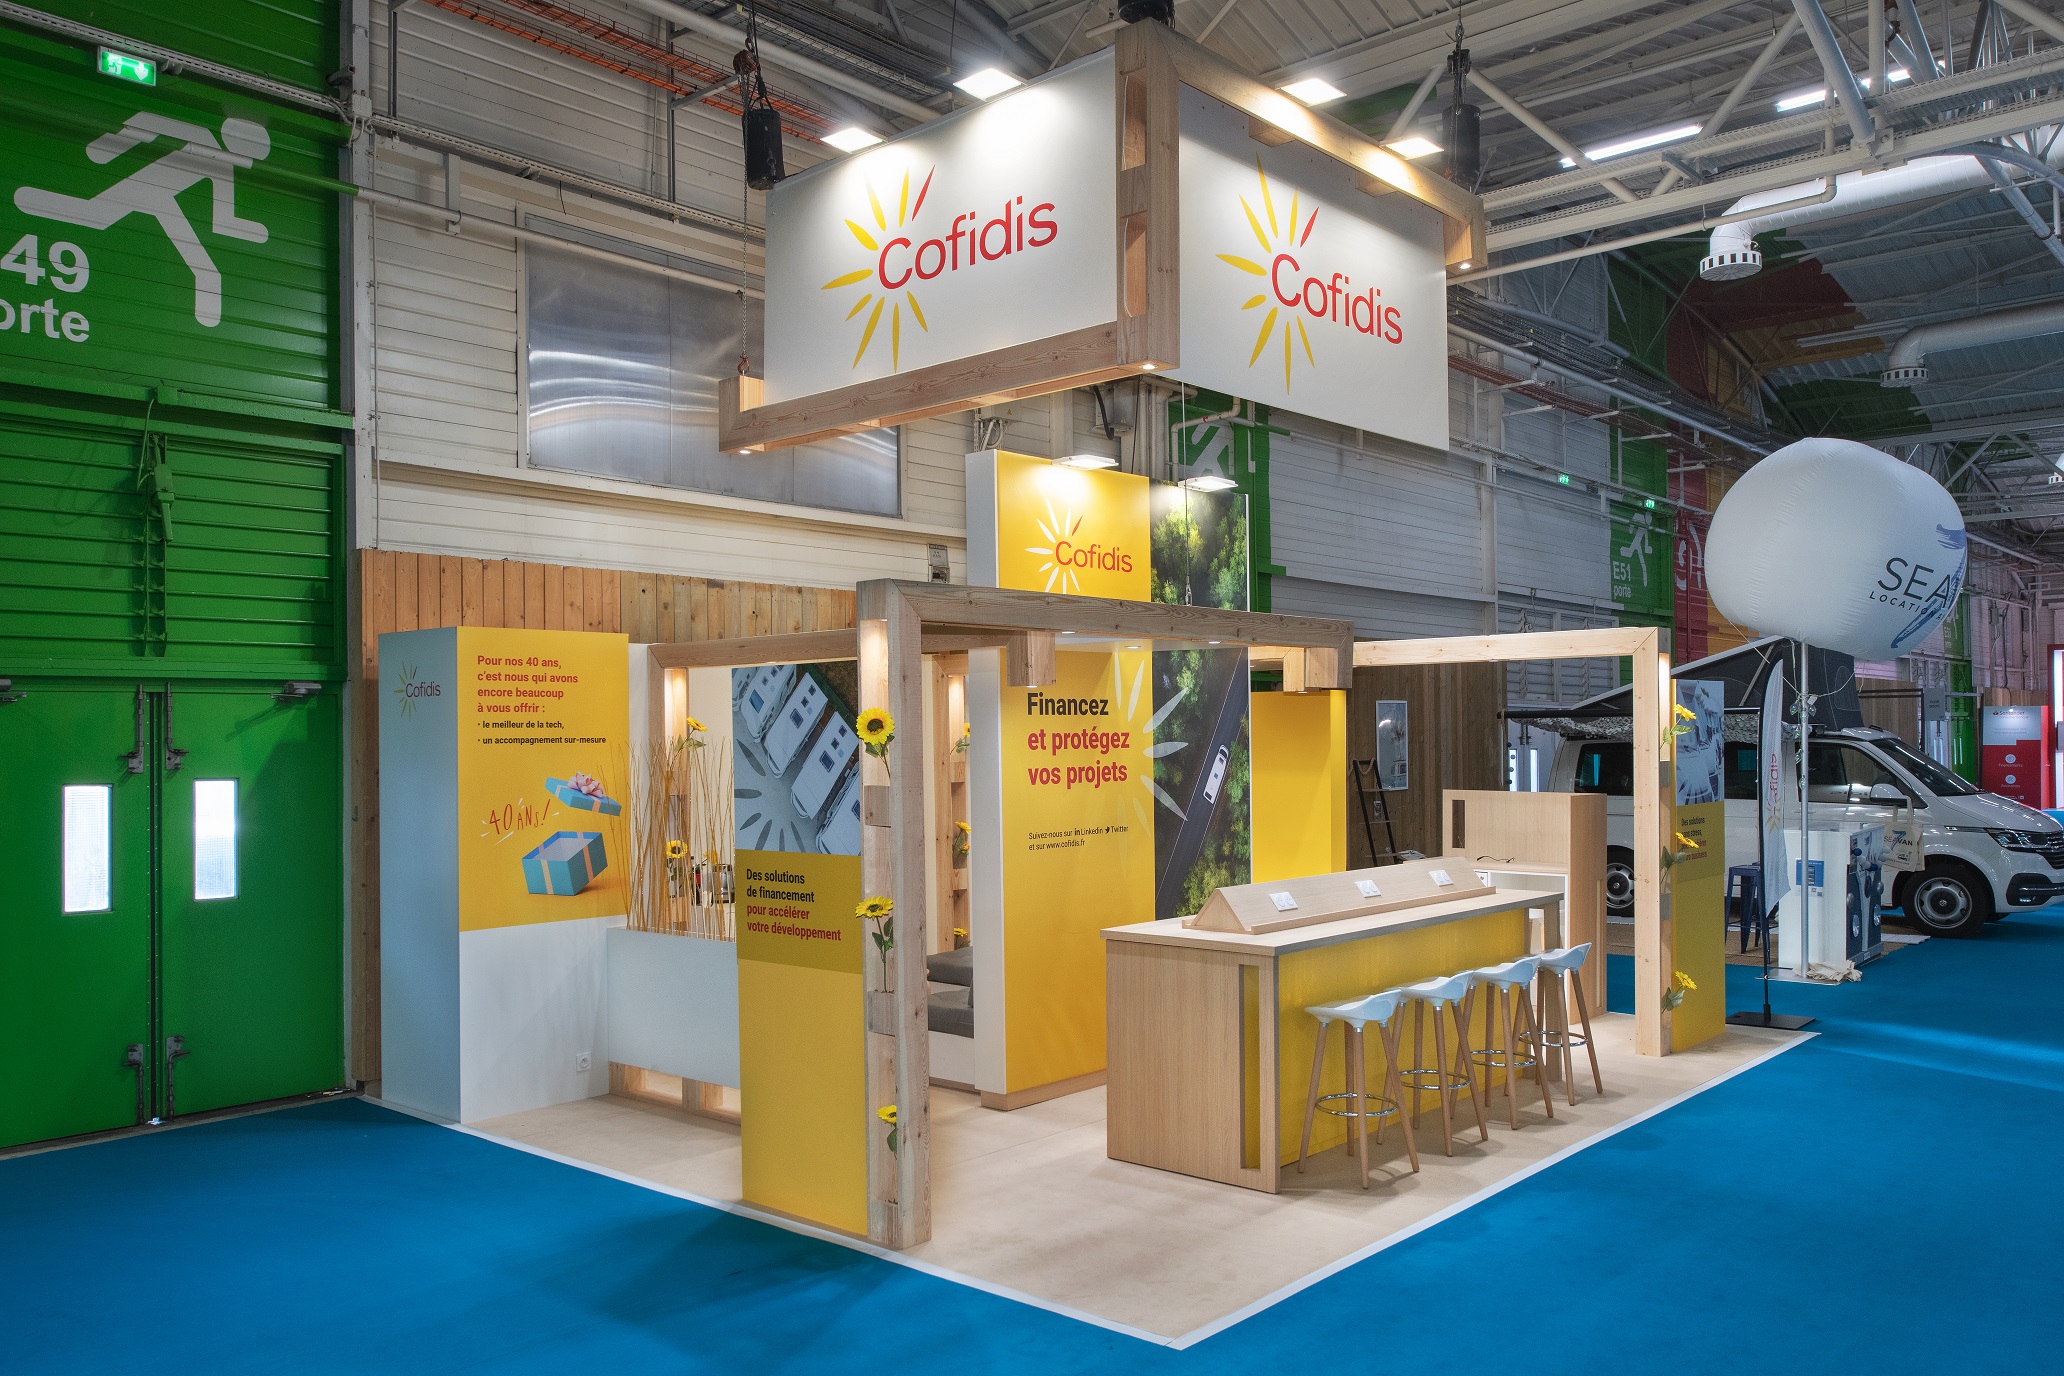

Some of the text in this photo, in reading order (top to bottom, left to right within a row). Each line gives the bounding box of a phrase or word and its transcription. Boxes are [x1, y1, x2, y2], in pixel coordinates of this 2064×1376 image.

[878, 195, 1058, 290] Cofidis
[1271, 253, 1403, 345] Cofidis
[1055, 540, 1133, 573] Cofidis
[1612, 560, 1631, 582] E51
[1614, 584, 1632, 600] porte
[477, 655, 562, 670] Pour nos 40 ans,
[477, 671, 578, 684] c'est nous qui avons
[405, 681, 441, 698] Cofidis
[477, 687, 564, 700] encore beaucoup
[477, 702, 484, 713] à
[486, 704, 511, 713] vous
[514, 702, 539, 713] offrir
[1027, 692, 1109, 716] Financez
[492, 720, 524, 728] meilleur
[546, 721, 564, 729] tech,
[494, 737, 563, 745] accompagnement
[1028, 726, 1130, 756] et protégez
[1028, 760, 1128, 790] vos projets
[489, 803, 513, 835] 40
[1028, 831, 1063, 840] Suivez-nous
[1046, 839, 1085, 849] www.cofidis.fr
[746, 868, 805, 884] Des solutions
[746, 885, 815, 902] de financement
[747, 905, 810, 920] pour accélérer
[747, 921, 841, 941] votre développement
